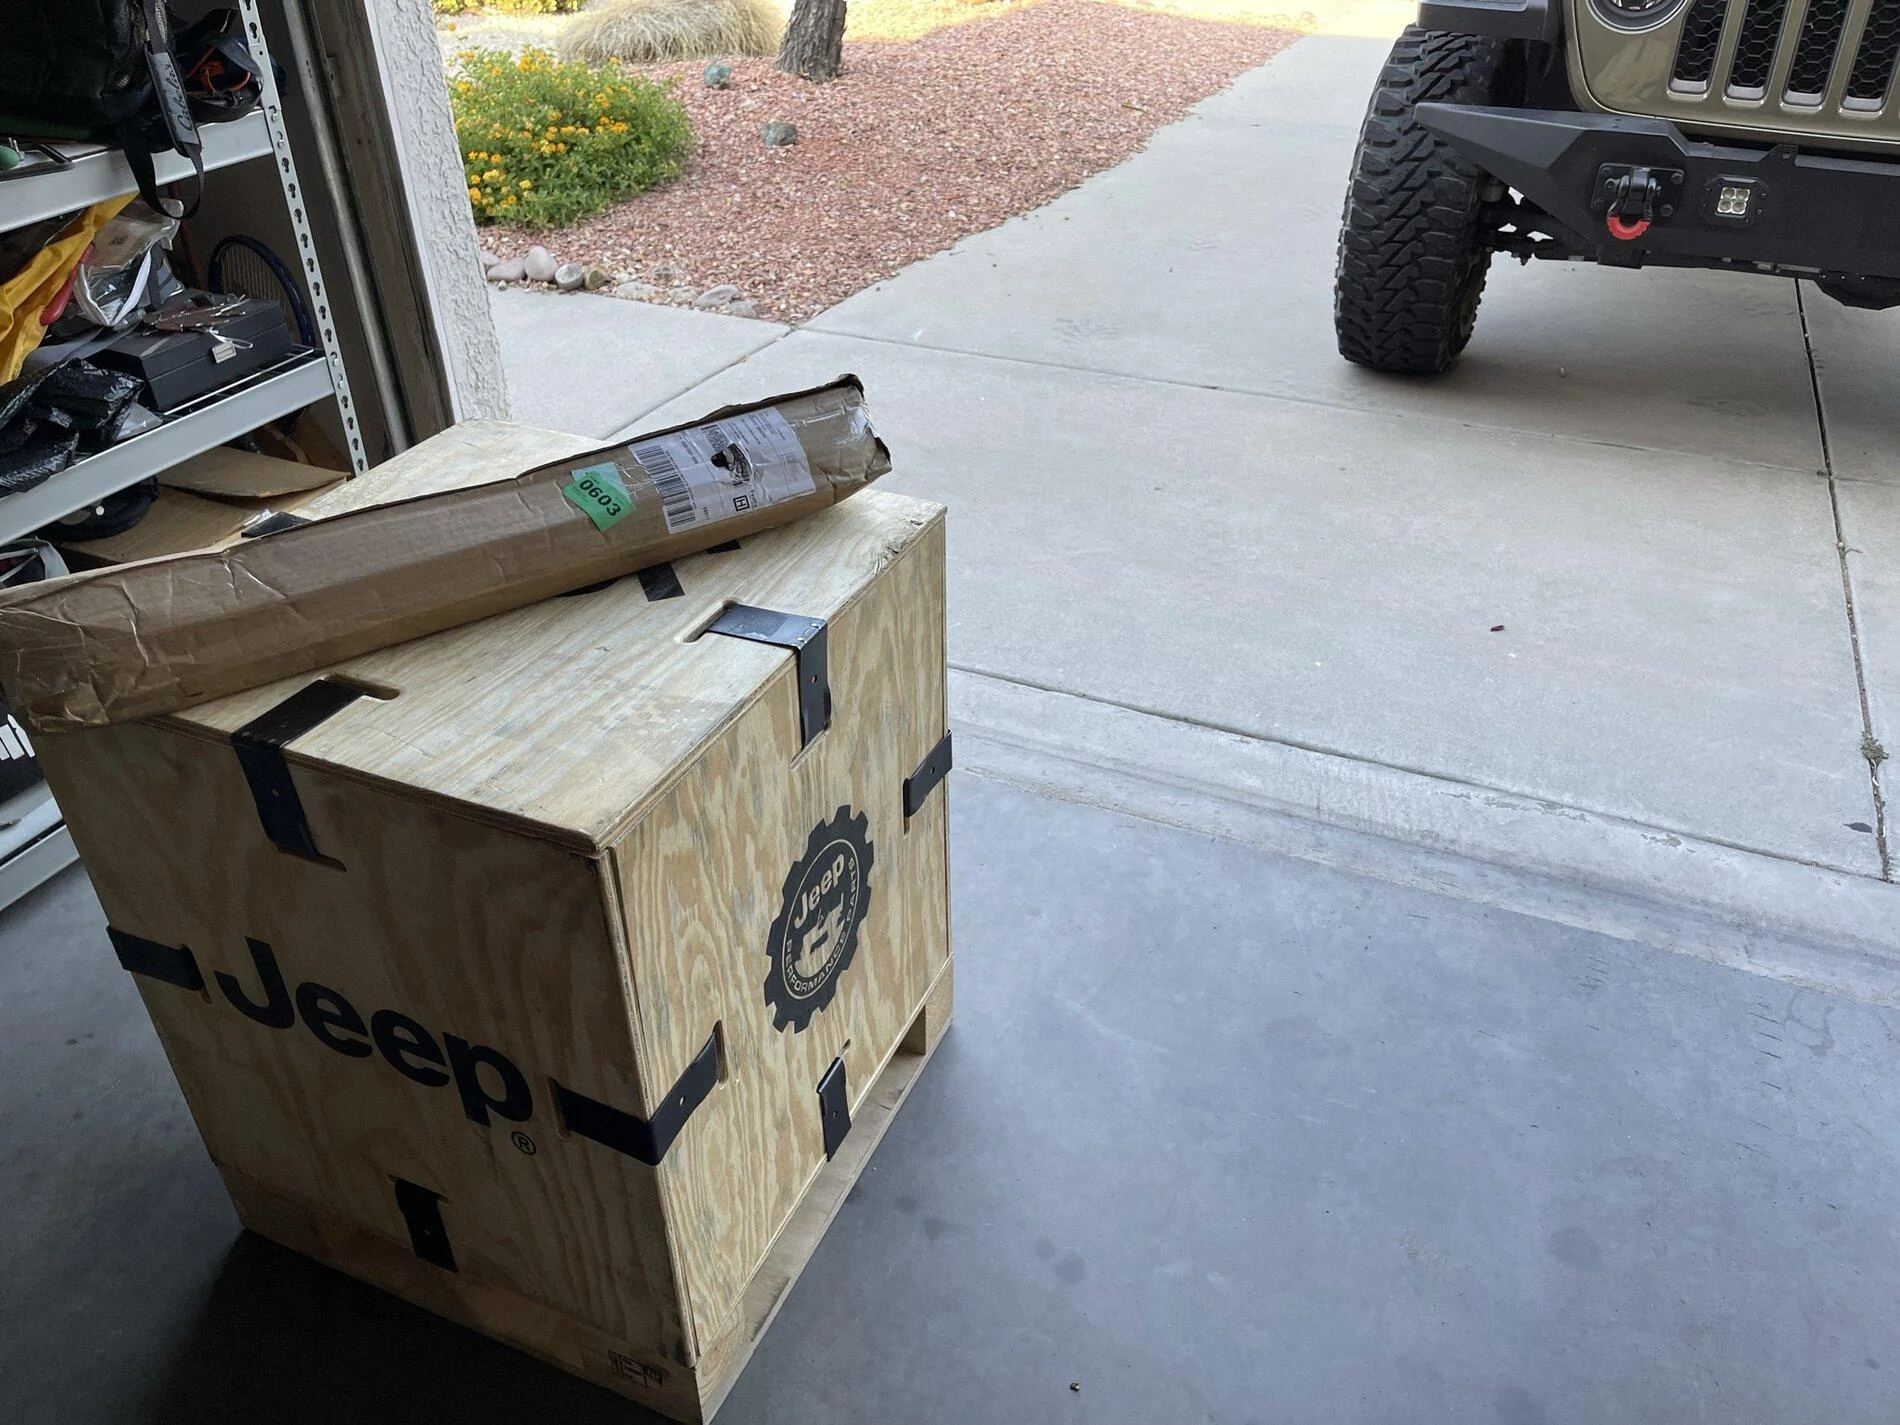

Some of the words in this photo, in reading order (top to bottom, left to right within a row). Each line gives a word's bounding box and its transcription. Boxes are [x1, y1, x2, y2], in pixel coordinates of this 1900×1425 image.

[580, 480, 621, 516] 0603
[785, 930, 848, 993] PERFORMANCE
[845, 857, 858, 922] PARTS
[794, 853, 845, 930] Jeep
[213, 936, 533, 1128] Jeep
